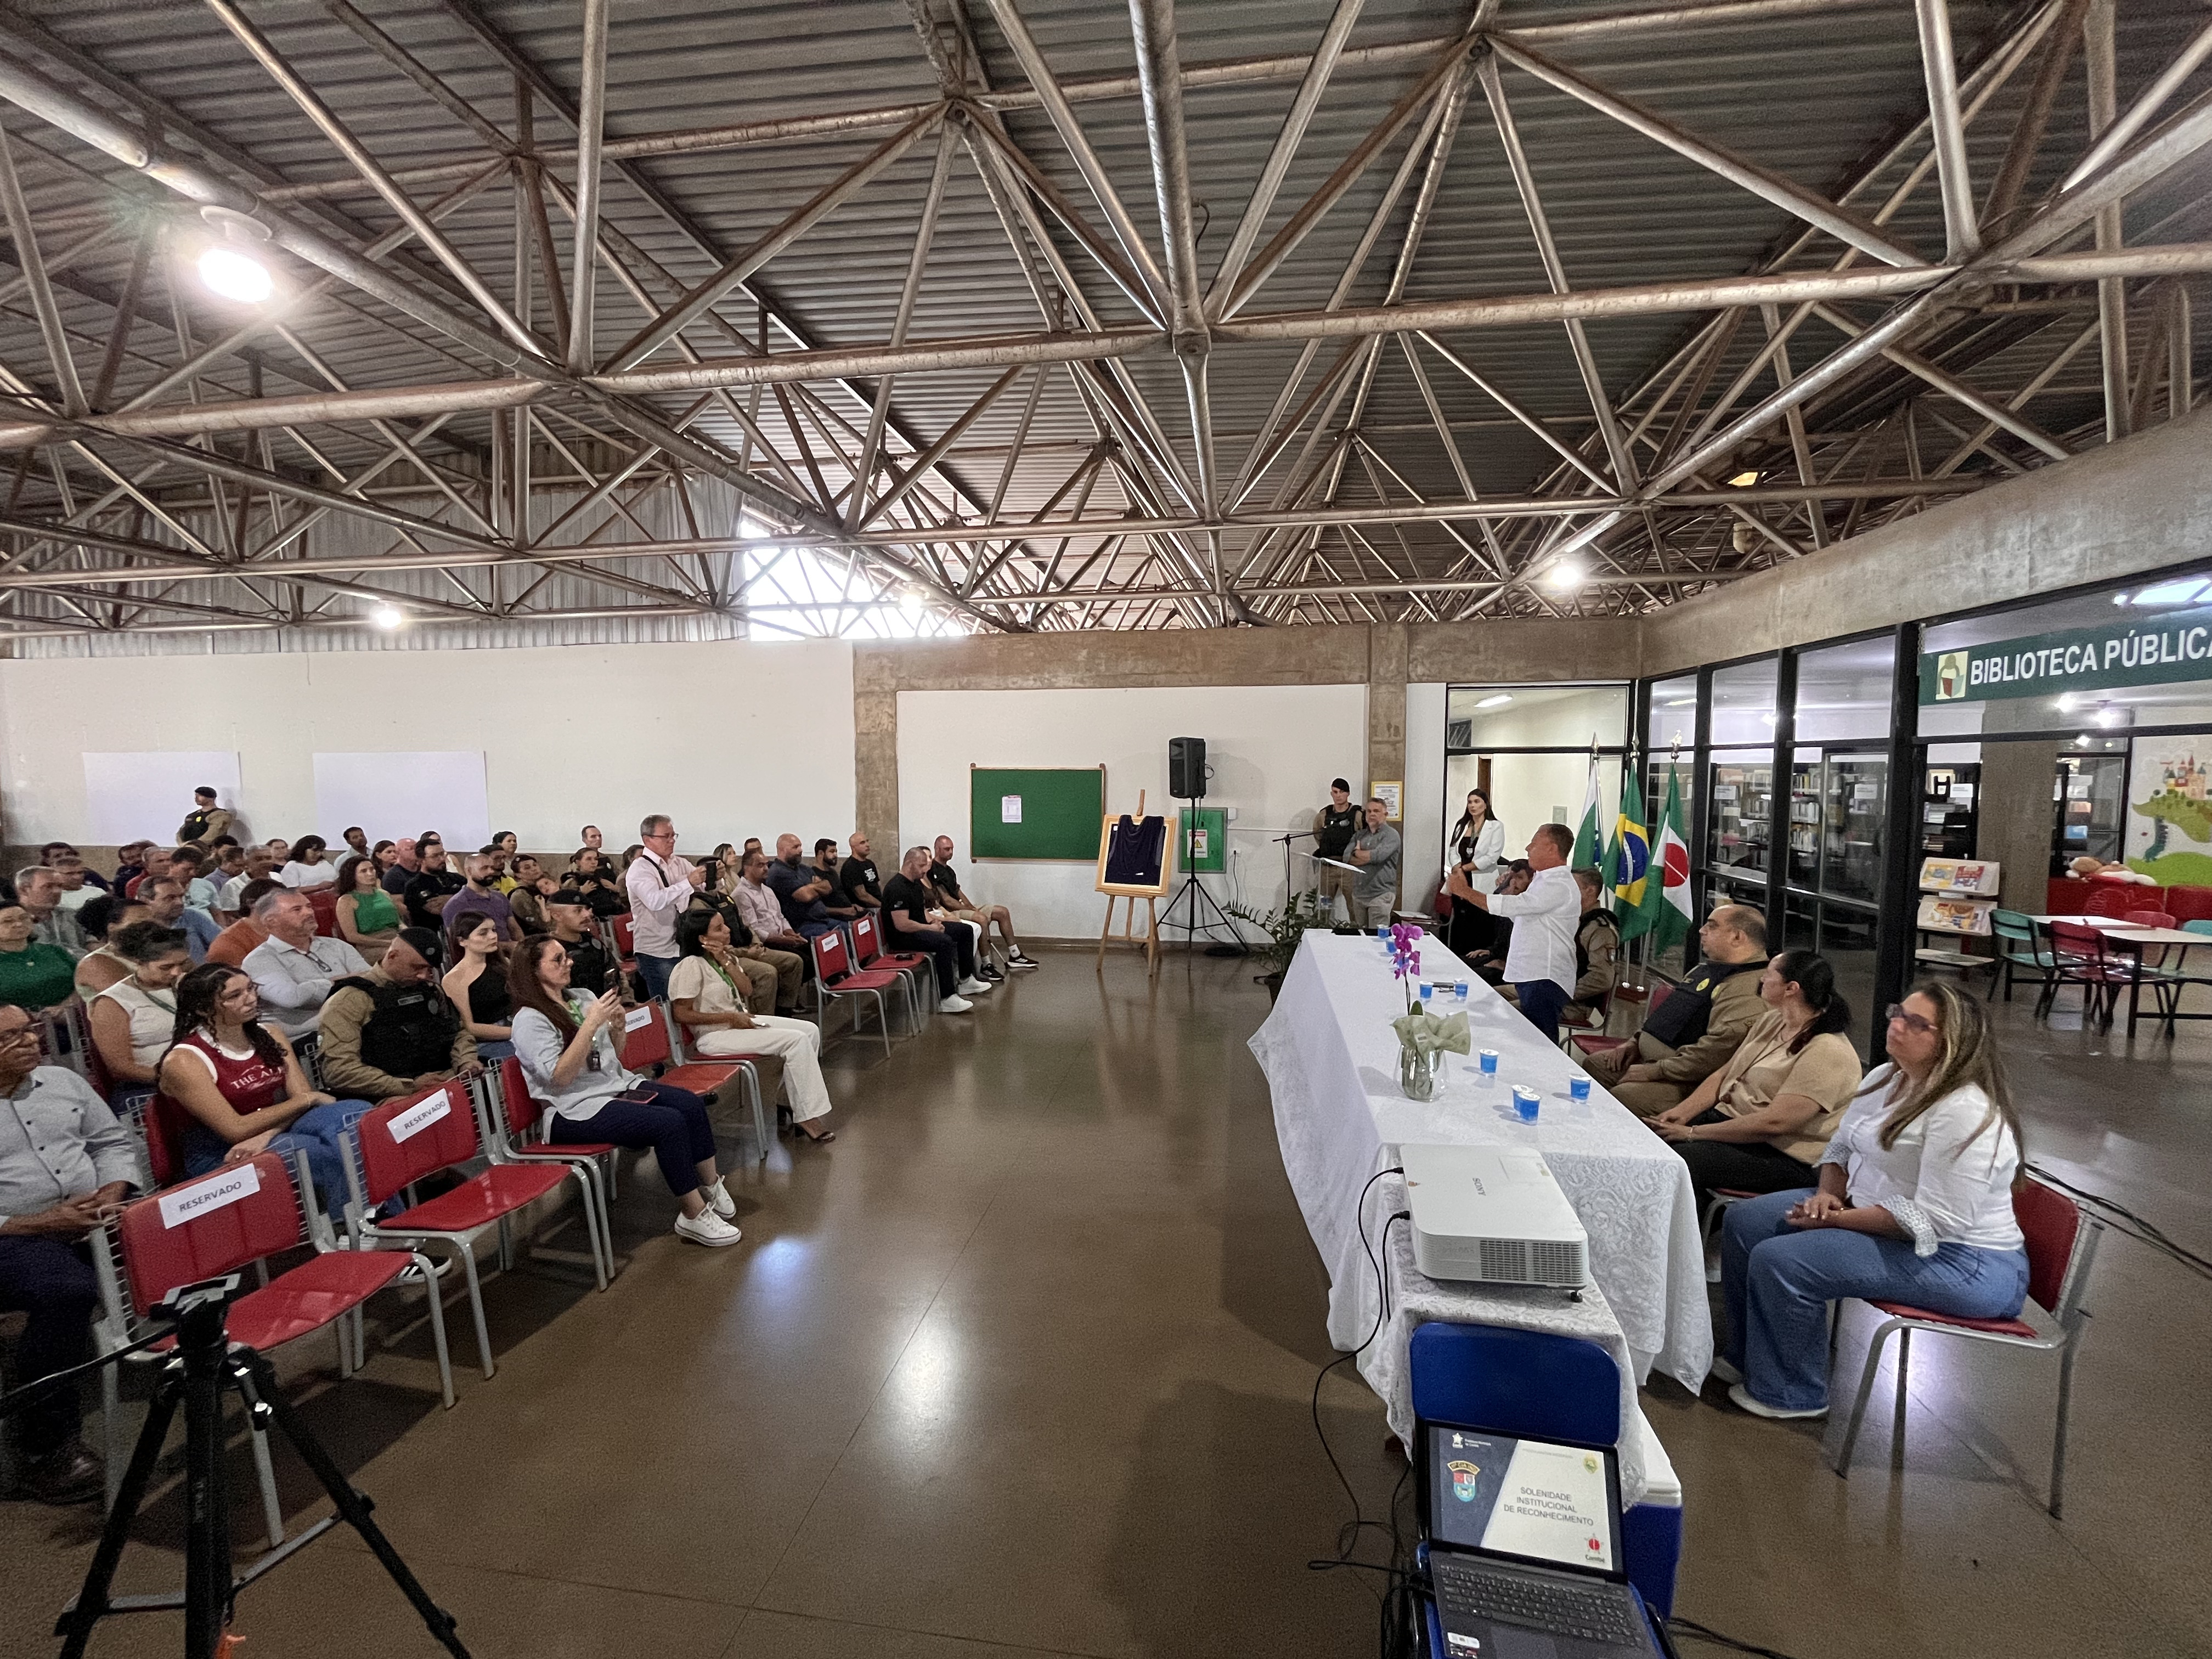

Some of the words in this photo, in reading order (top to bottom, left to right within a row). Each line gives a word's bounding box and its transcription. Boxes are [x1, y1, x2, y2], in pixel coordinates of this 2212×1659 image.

[1970, 643, 2097, 685] BIBLIOTECA
[2104, 627, 2212, 669] PÚBLIC
[230, 1074, 257, 1089] THE
[404, 1101, 445, 1129] RESERVADO
[179, 1182, 241, 1211] RESERVADO
[1472, 1178, 1486, 1196] SONY
[1520, 1486, 1572, 1502] SOLENIDADE
[1503, 1504, 1515, 1513] DE
[1517, 1506, 1594, 1526] RECONHECIMENTO
[1516, 1497, 1577, 1513] INSTITUCIONAL
